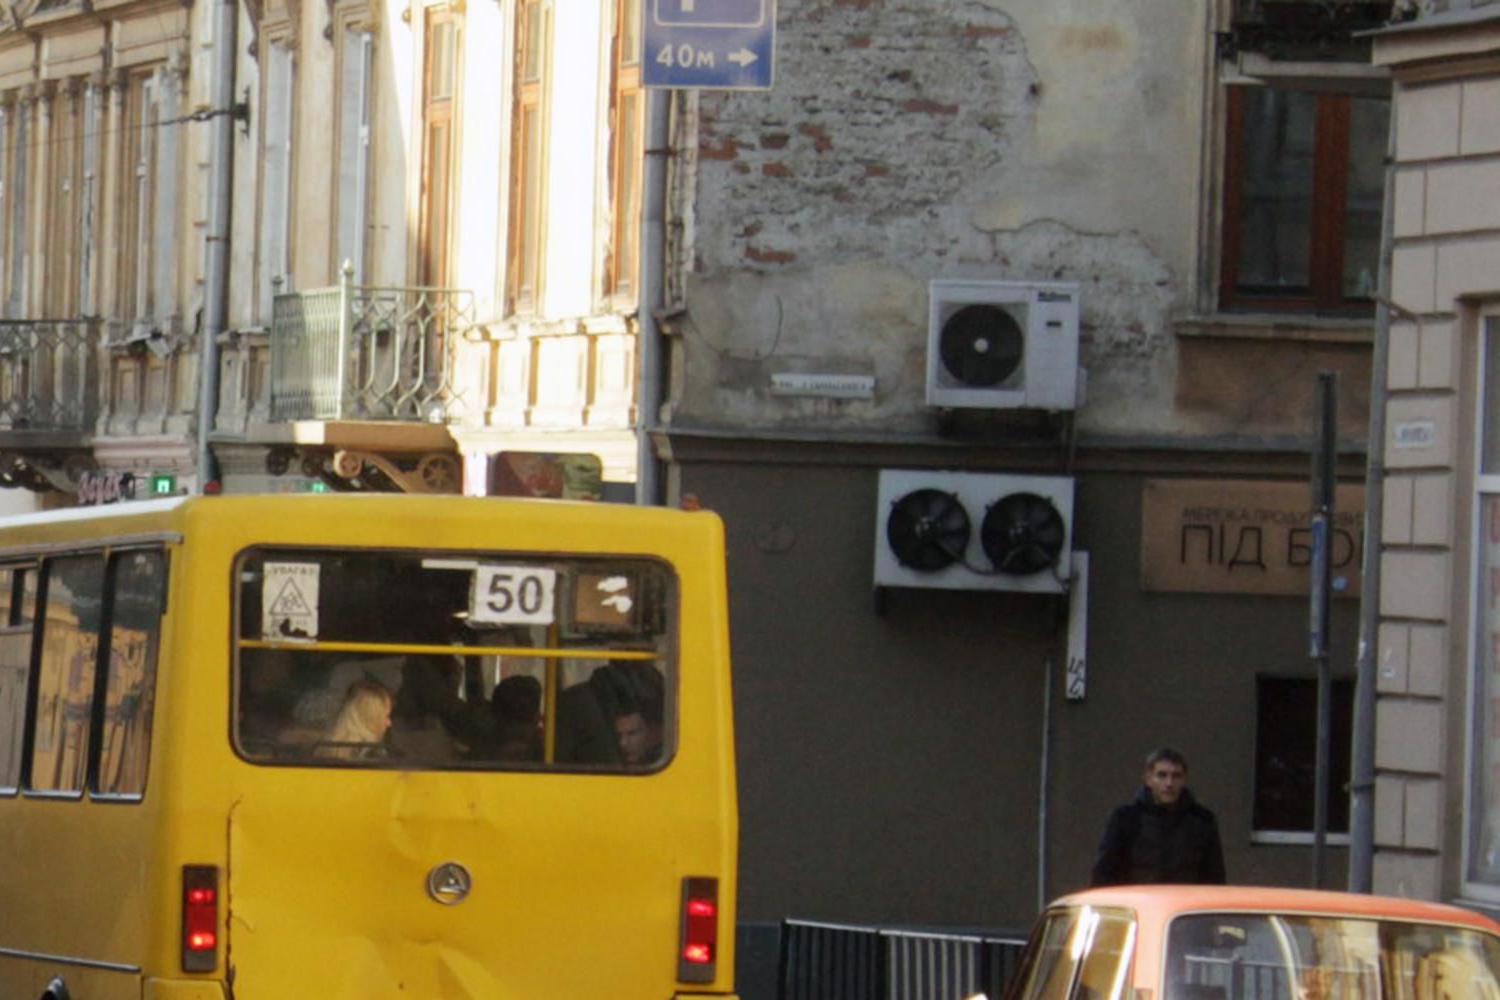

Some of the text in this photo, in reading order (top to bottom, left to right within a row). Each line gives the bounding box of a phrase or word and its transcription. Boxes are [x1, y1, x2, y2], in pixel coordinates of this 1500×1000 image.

[1181, 523, 1364, 571] ПІД БО
[486, 574, 543, 615] 50
